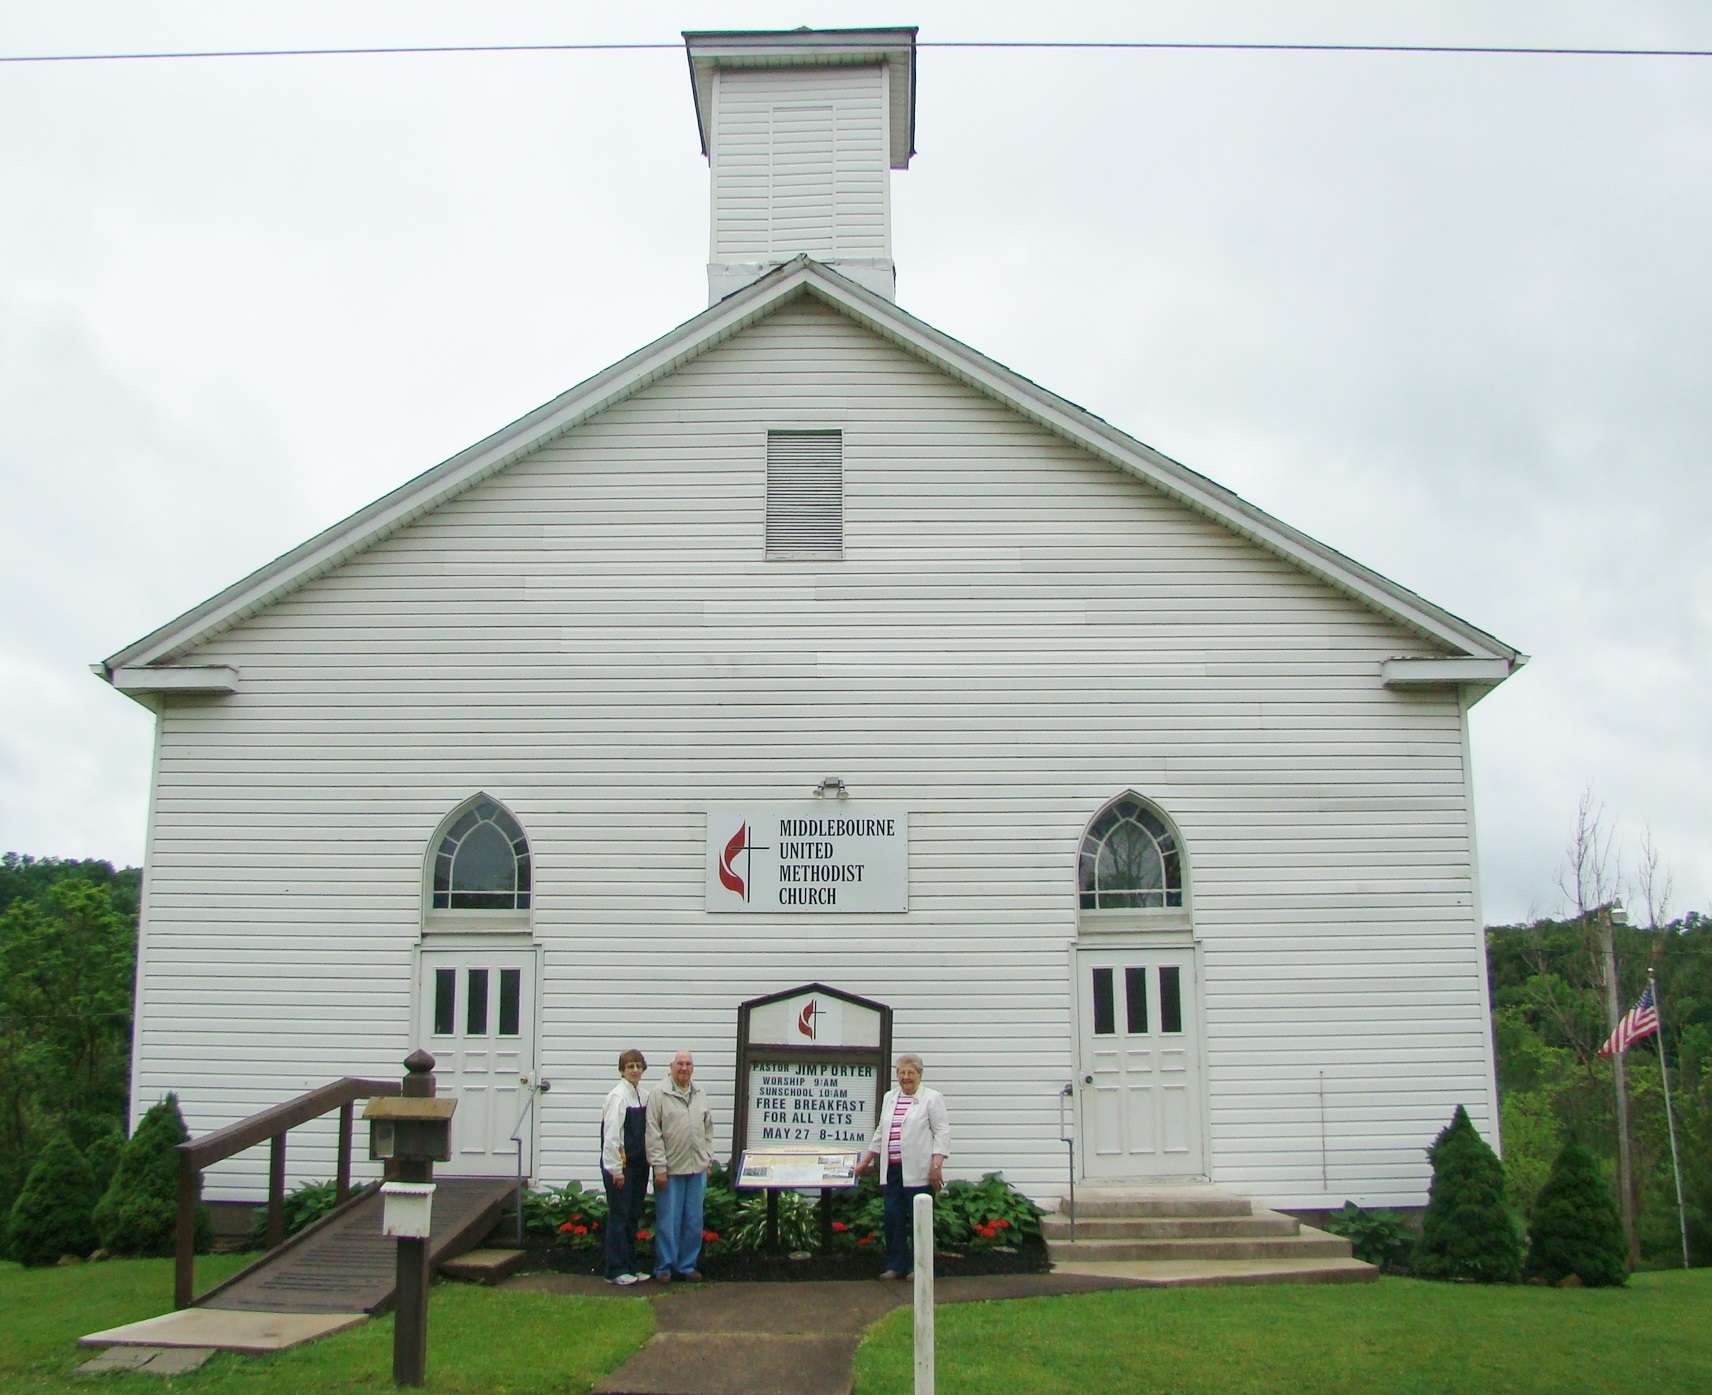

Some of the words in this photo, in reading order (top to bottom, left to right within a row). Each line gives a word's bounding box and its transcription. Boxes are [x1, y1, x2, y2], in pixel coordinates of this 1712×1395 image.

[780, 819, 895, 836] MIDDLEBOURNE
[780, 842, 834, 859] UNITED
[779, 865, 864, 882] METHODIST
[779, 888, 836, 905] CHURCH
[753, 1064, 789, 1072] PASTOR
[795, 1065, 817, 1076] JIM
[821, 1066, 872, 1077] PORTER
[763, 1077, 805, 1086] WORSHIP
[814, 1079, 838, 1087] 9:AM
[819, 1089, 848, 1098] 10:AM
[757, 1098, 786, 1109] FREE
[794, 1100, 865, 1111] BREAKFAST
[763, 1111, 787, 1123] FOR
[792, 1113, 814, 1124] ALL
[821, 1113, 852, 1124] VETS
[763, 1127, 791, 1139] MAY
[795, 1129, 810, 1140] 27
